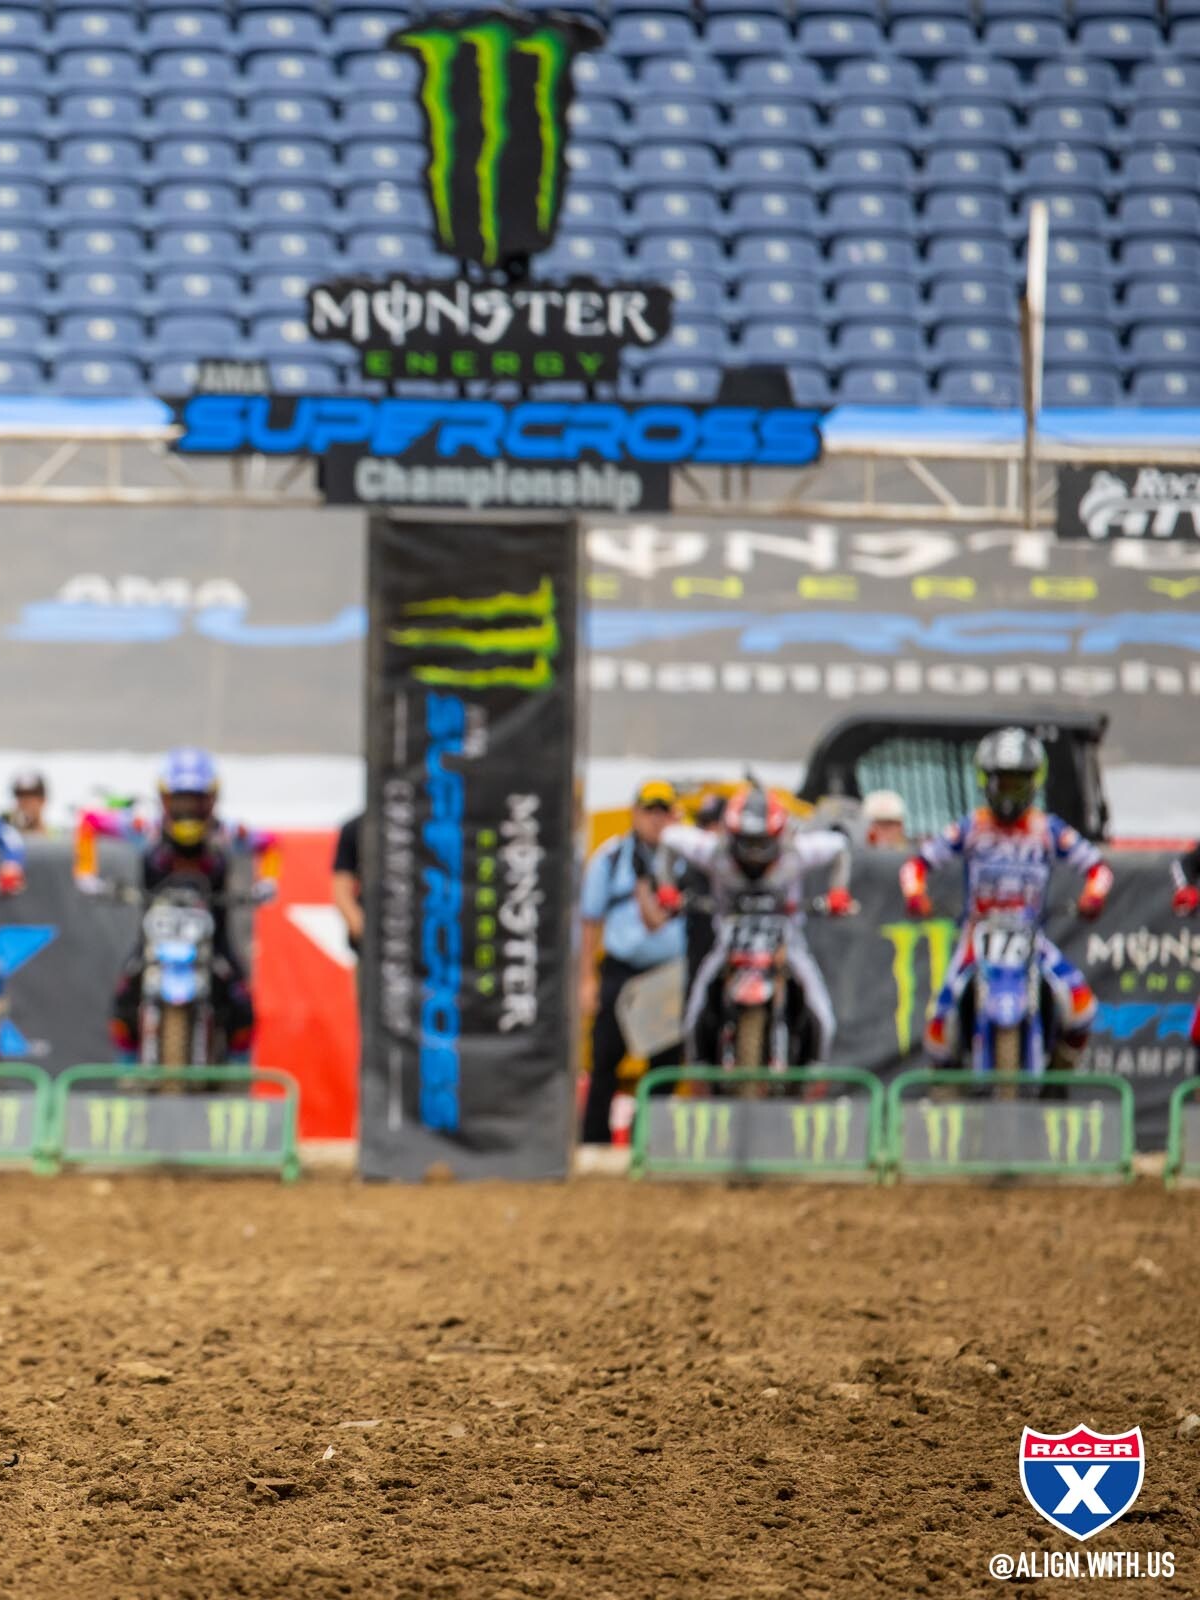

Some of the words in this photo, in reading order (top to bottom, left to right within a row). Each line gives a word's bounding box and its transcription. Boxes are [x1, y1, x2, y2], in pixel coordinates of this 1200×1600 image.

[311, 279, 655, 346] MONSTER
[364, 349, 603, 379] ENERGY
[179, 394, 822, 463] SUPERCROSS
[354, 460, 642, 508] Championship
[498, 794, 546, 1032] MONSTER
